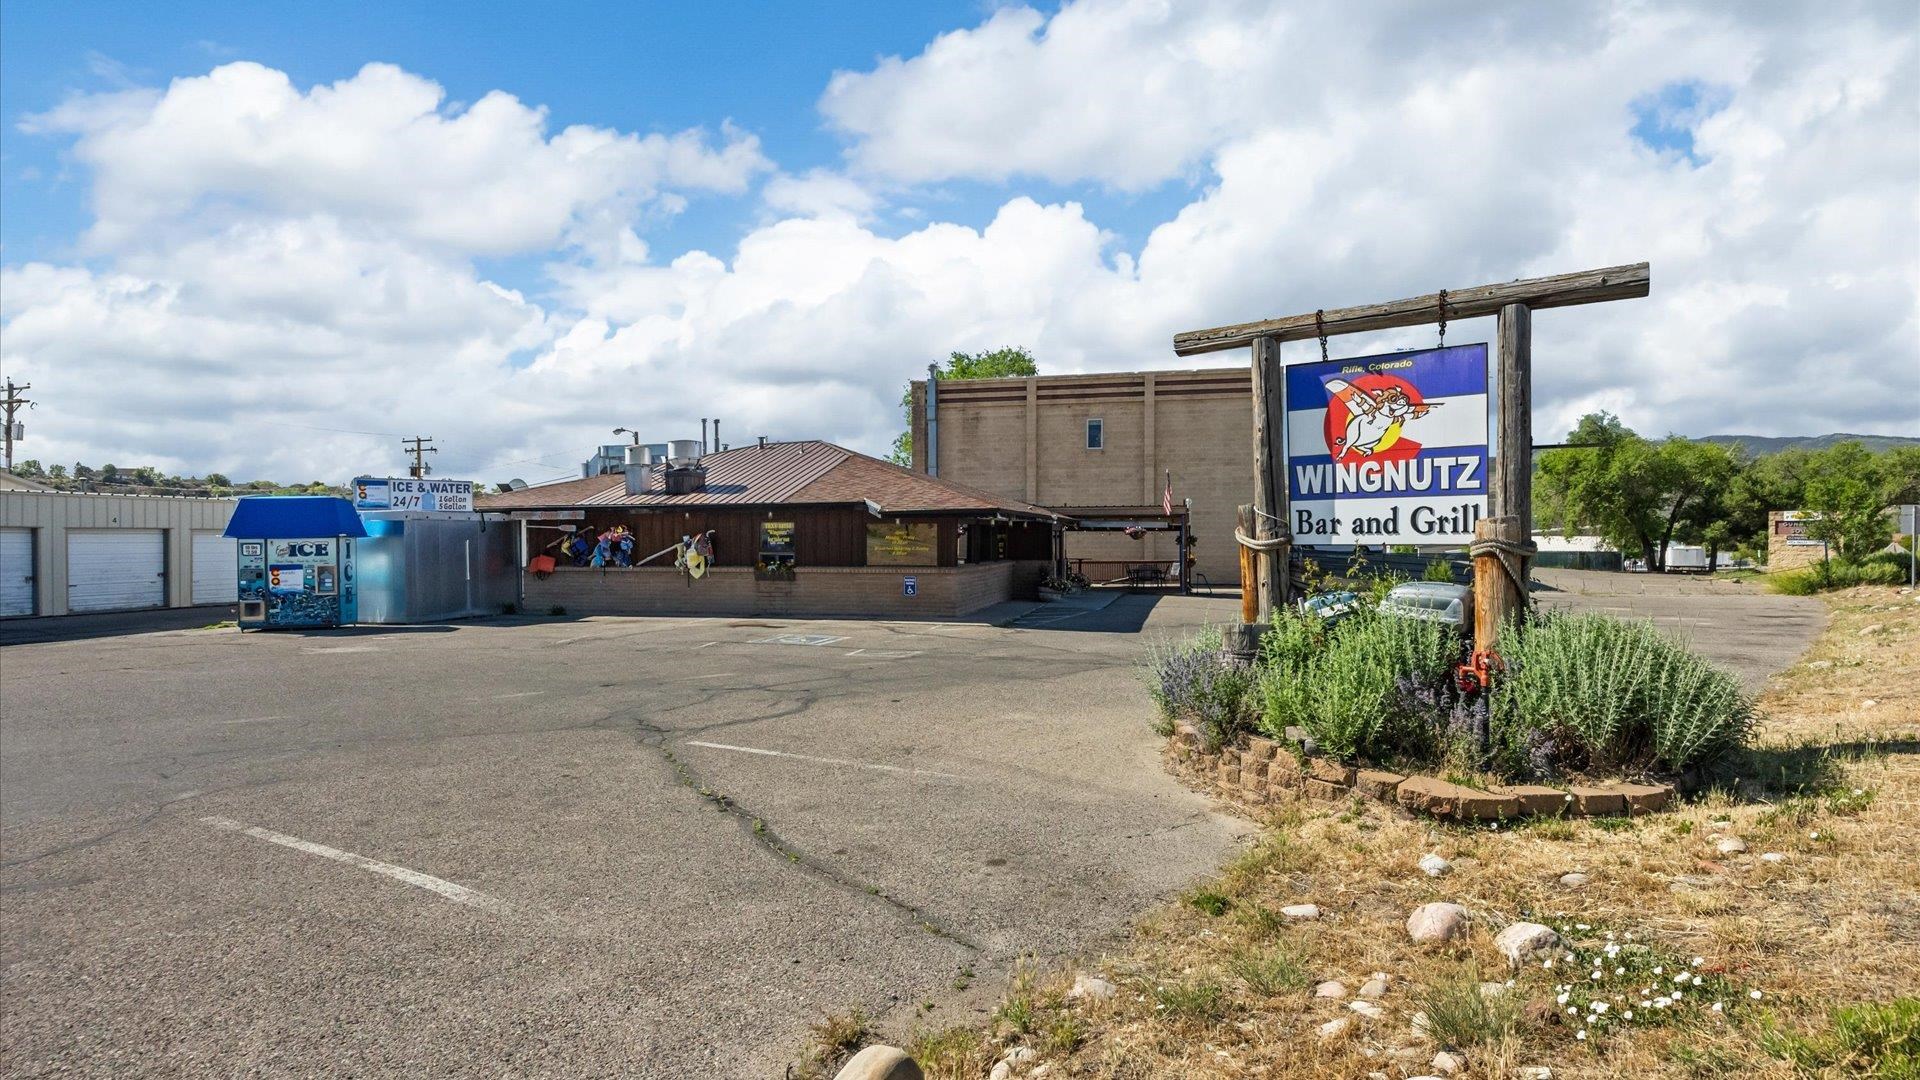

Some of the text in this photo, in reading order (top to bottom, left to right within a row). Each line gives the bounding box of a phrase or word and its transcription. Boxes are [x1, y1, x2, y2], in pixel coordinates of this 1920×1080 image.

[1368, 359, 1412, 371] Colorado
[1296, 456, 1481, 495] WINGNUTZ
[392, 481, 471, 494] ICE & WATER
[393, 496, 420, 509] 24/7
[1296, 503, 1479, 536] Bar and Grill
[288, 541, 329, 557] ICE
